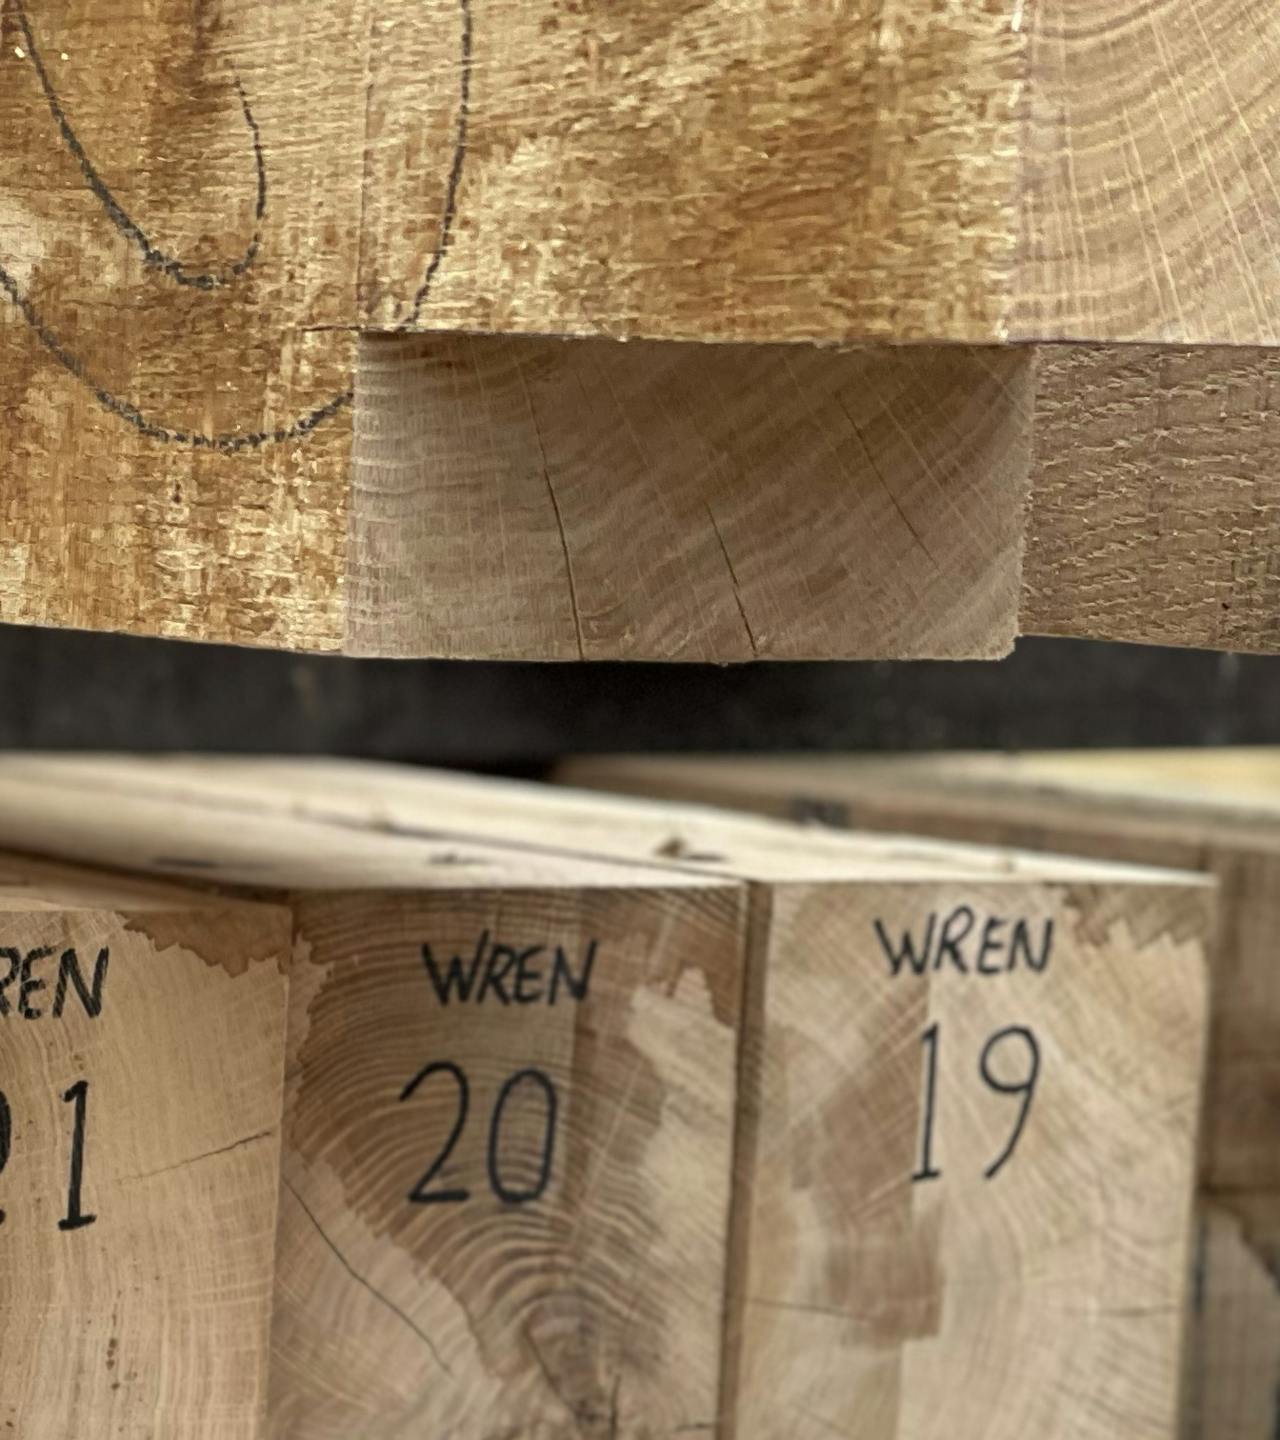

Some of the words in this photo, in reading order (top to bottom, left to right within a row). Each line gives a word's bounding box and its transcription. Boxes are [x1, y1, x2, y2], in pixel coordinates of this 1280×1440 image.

[422, 928, 600, 1008] WREN
[873, 906, 1054, 979] WREN
[397, 1060, 561, 1205] 20
[910, 1024, 1041, 1183] 19
